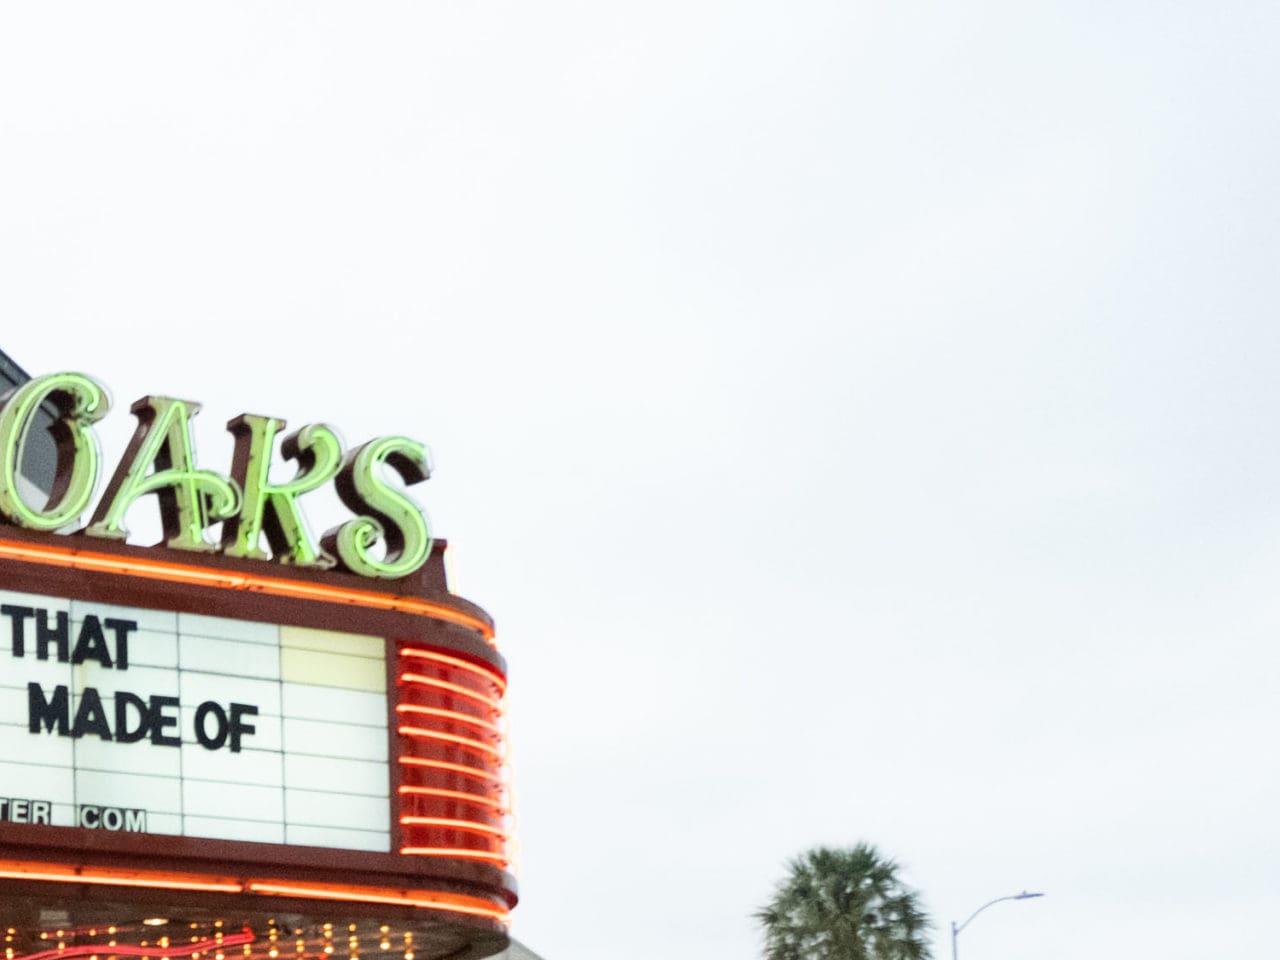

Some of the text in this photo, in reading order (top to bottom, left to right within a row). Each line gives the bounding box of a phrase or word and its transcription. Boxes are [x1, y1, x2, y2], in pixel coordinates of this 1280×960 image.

[0, 604, 138, 671] THAT
[27, 682, 182, 748] MADE
[193, 699, 259, 754] OF
[80, 804, 148, 834] COM
